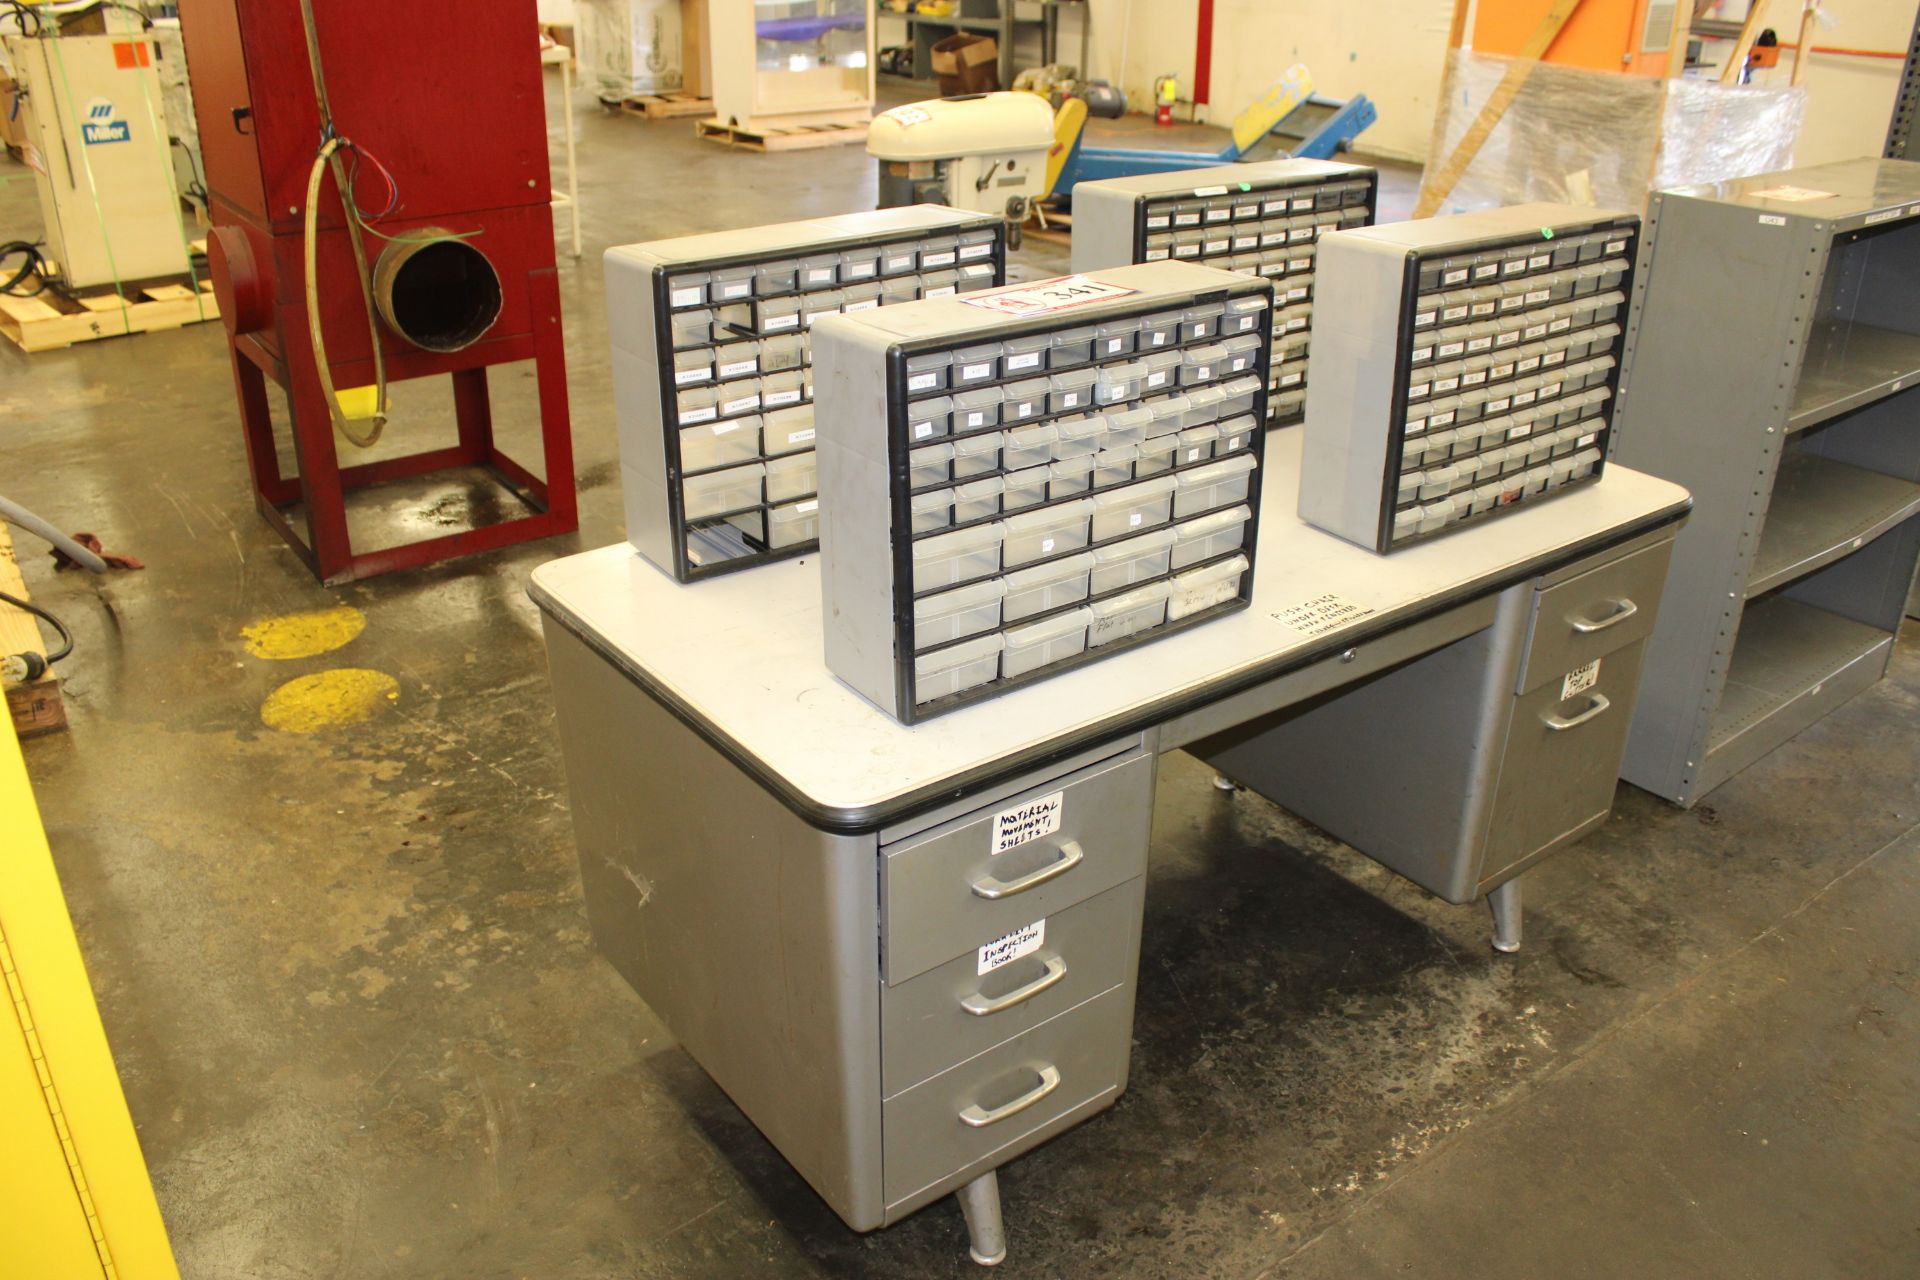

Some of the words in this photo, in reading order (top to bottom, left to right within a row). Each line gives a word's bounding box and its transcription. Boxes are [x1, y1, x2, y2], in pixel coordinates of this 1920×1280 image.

[86, 126, 124, 143] Miller
[1043, 284, 1107, 300] 341
[1270, 606, 1303, 620] PUSH
[1285, 611, 1316, 626] UNDER
[983, 930, 1038, 963] INSPECTION
